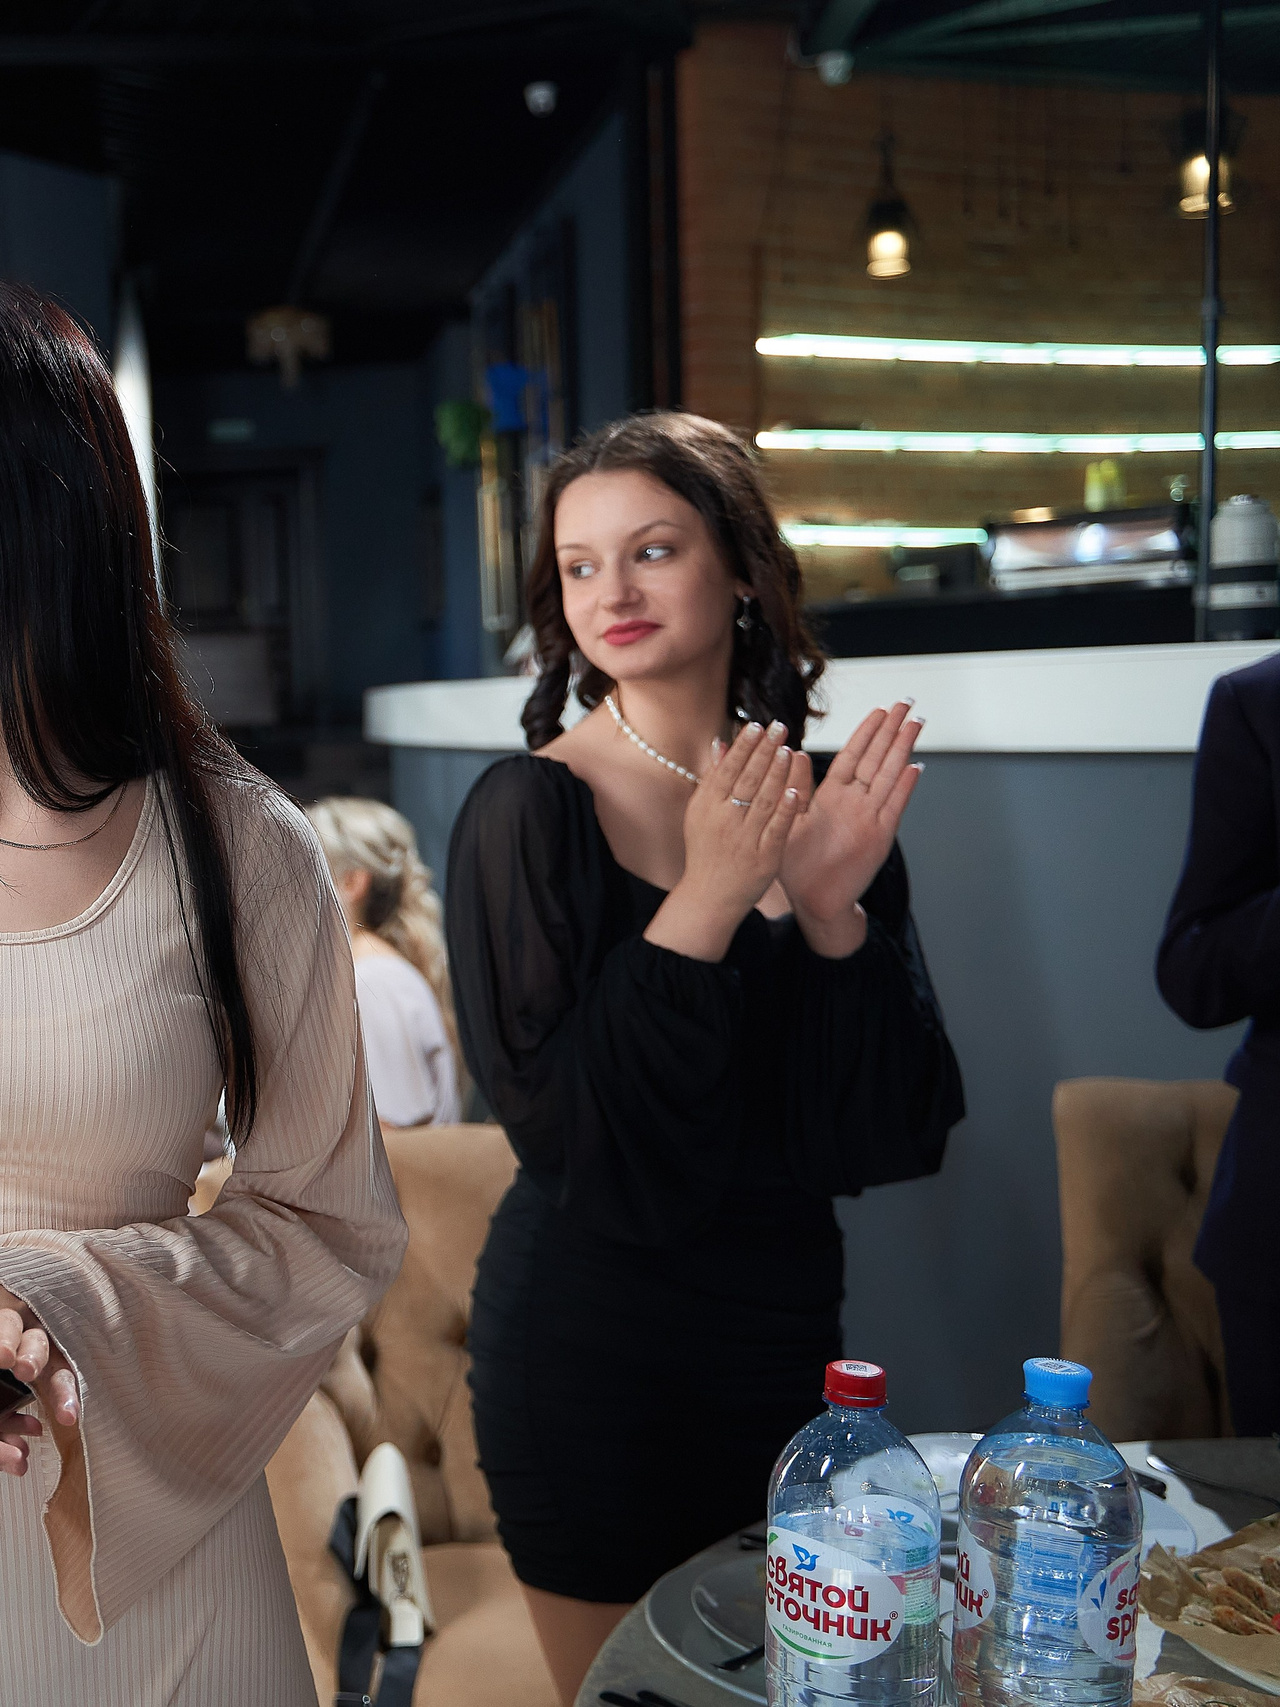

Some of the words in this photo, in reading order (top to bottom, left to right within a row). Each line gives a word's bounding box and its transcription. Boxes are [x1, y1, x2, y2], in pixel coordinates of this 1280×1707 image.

[765, 1580, 892, 1642] СТОЧНИК
[767, 1554, 870, 1613] СВЯТОЙ
[782, 1623, 833, 1649] ГАЗИРОВАННАЯ
